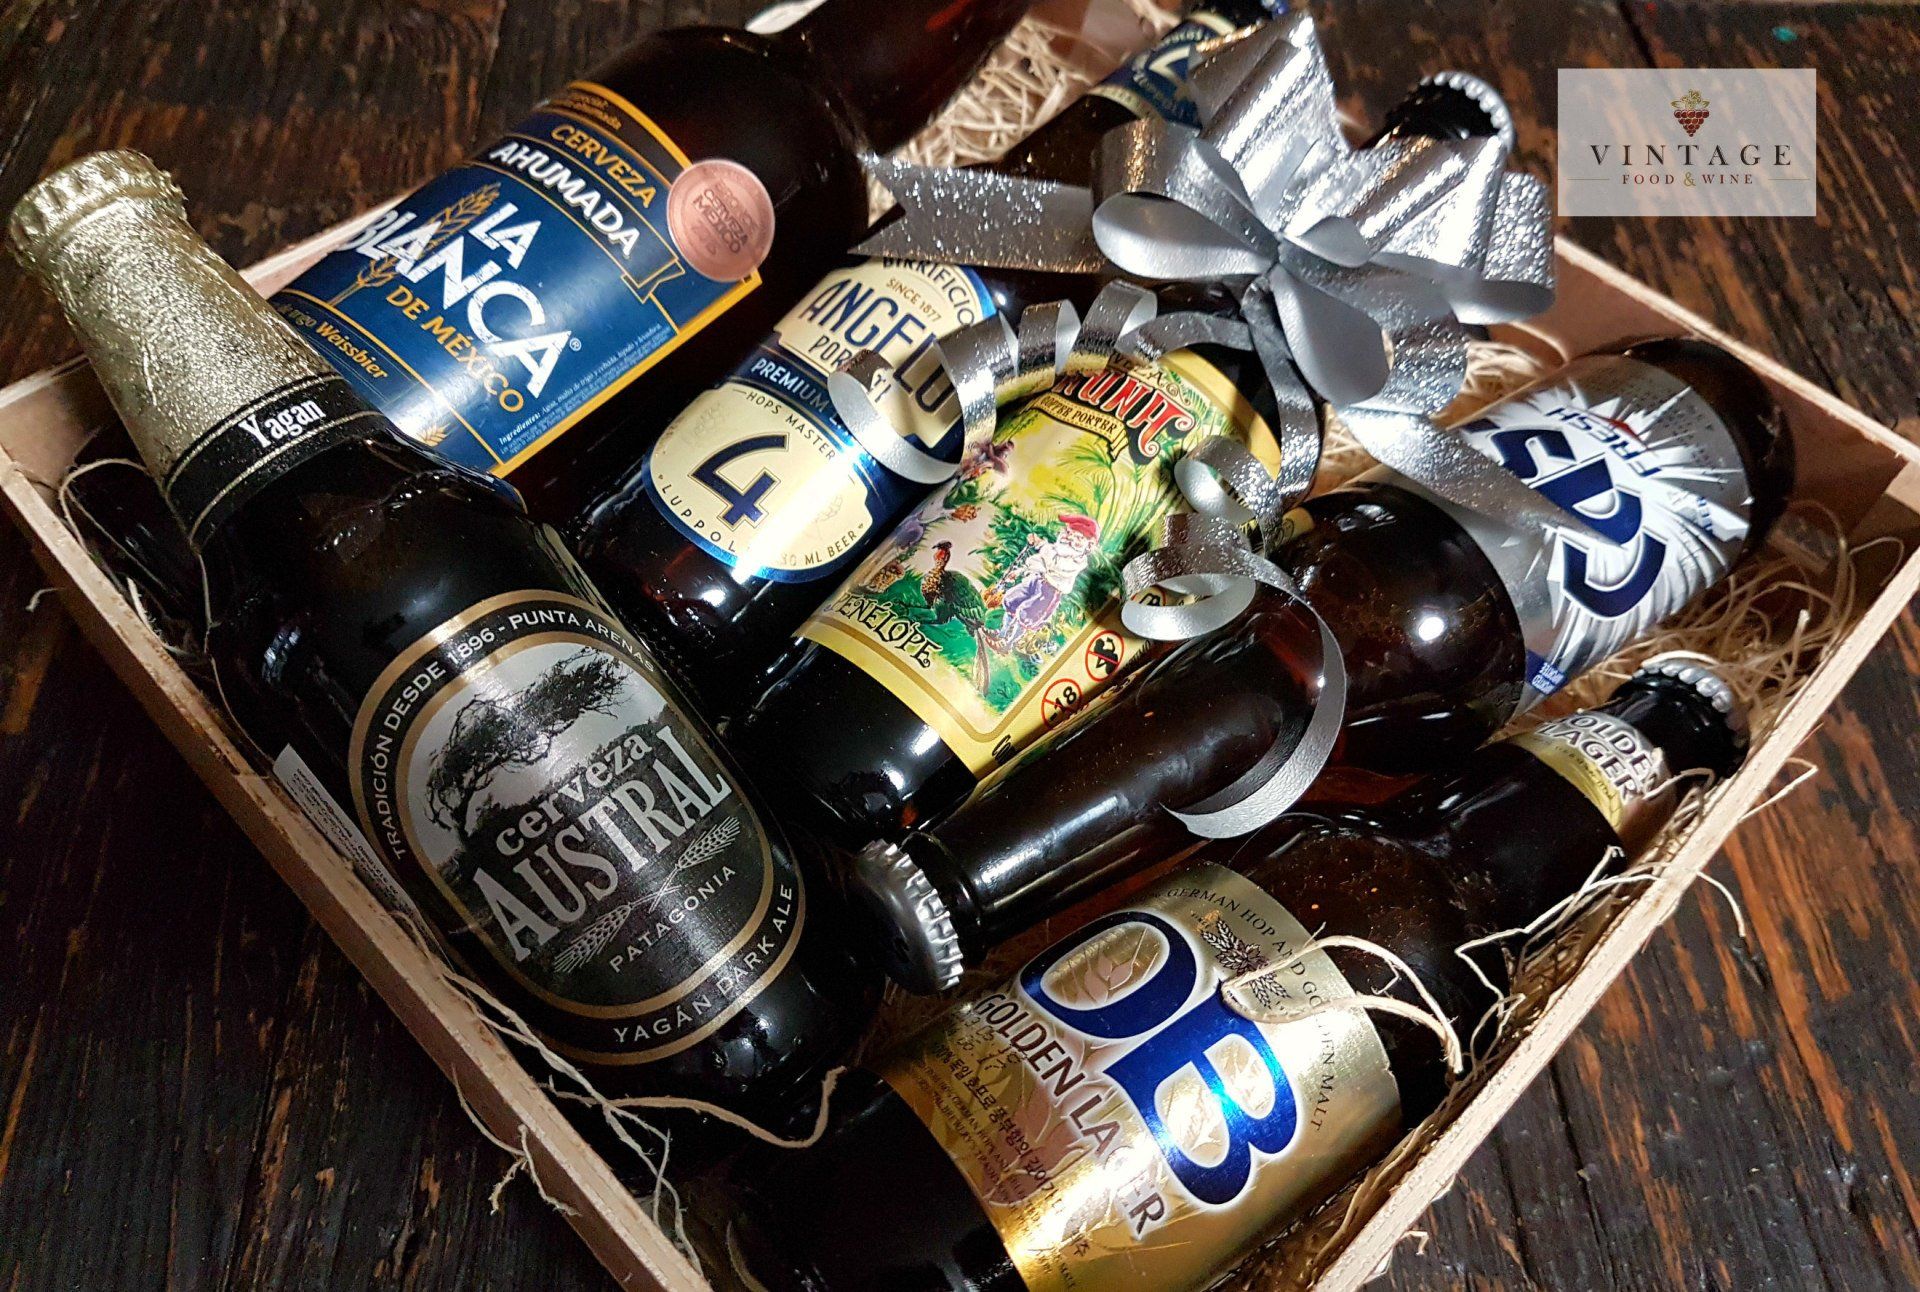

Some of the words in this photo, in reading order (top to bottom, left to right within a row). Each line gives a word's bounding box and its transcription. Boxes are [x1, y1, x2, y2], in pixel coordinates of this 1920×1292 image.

[488, 141, 640, 257] AHUMADA
[551, 123, 656, 209] CERVEZA
[468, 202, 543, 270] LA
[340, 207, 574, 399] BLANCA
[886, 278, 918, 305] SINCE
[919, 301, 943, 322] 1877
[315, 321, 389, 379] Weissbier
[385, 285, 430, 321] DE
[421, 314, 524, 412] MÉXICO
[751, 357, 831, 414] PREMIUM
[238, 395, 326, 450] Yagan
[745, 390, 783, 415] HOPS
[785, 413, 836, 461] MASTER
[1072, 410, 1119, 434] PORTER
[1546, 407, 1663, 478] FRESH
[687, 432, 791, 531] 4
[827, 529, 858, 558] BEER
[447, 628, 496, 666] 1896
[508, 609, 579, 631] PUNTA
[585, 619, 655, 673] ARENAS
[828, 592, 943, 670] PENÉLOPE
[387, 661, 447, 730] DESDE
[1536, 724, 1638, 804] LAGER
[1562, 716, 1656, 783] OLDE
[369, 732, 406, 860] TRADICIÓN
[496, 732, 653, 856] cerveza
[473, 725, 733, 962] AUSTRAL
[609, 865, 737, 973] PATAGONIA
[612, 994, 713, 1044] YAGÁN
[715, 937, 776, 997] DARK
[774, 883, 793, 933] ALE
[974, 993, 1086, 1098] GOLDEN
[1166, 887, 1241, 912] GERMAN
[1239, 908, 1276, 936] HOP
[1310, 1074, 1335, 1131] MALT
[1018, 909, 1299, 1206] OB
